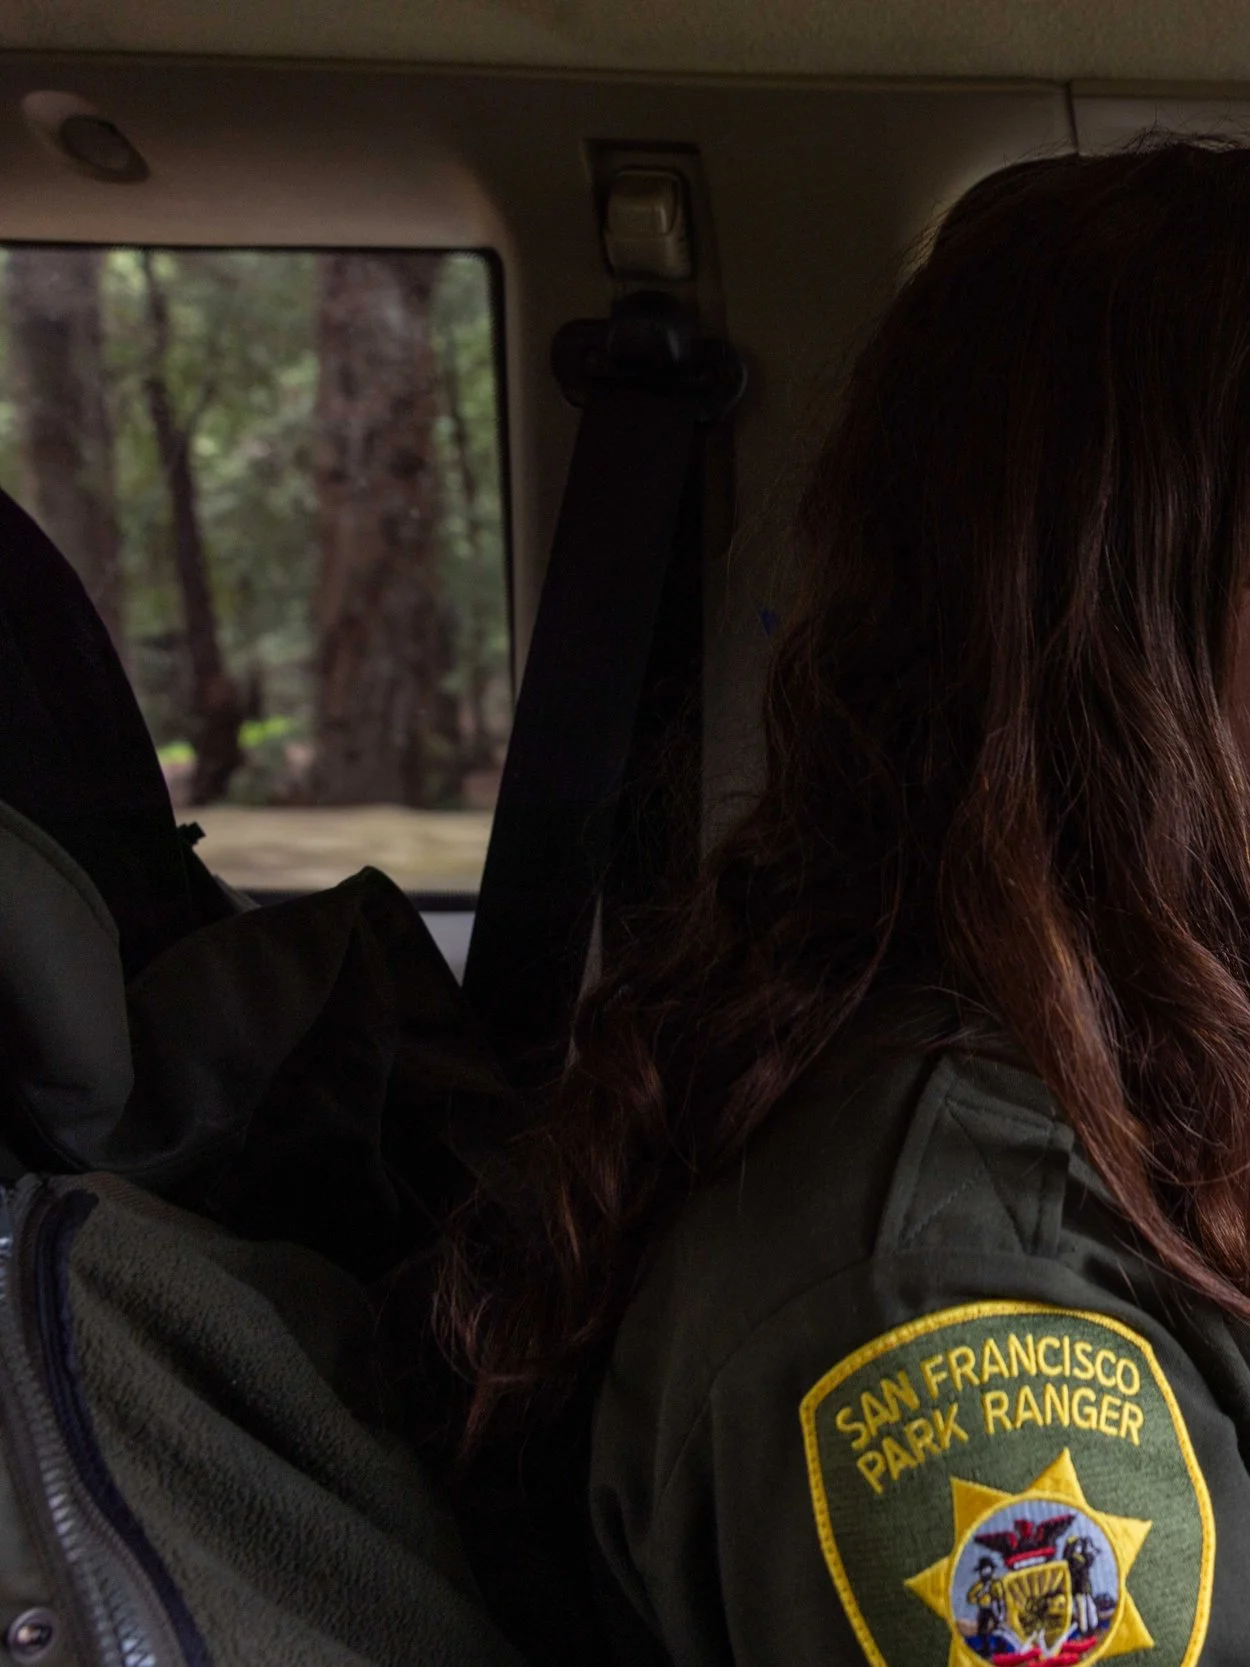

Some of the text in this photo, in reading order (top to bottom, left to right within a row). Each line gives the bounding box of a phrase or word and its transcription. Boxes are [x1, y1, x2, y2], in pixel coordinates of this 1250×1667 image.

[836, 1334, 1141, 1450] SAN FRANCISCO
[856, 1383, 1144, 1494] PARK RANGER
